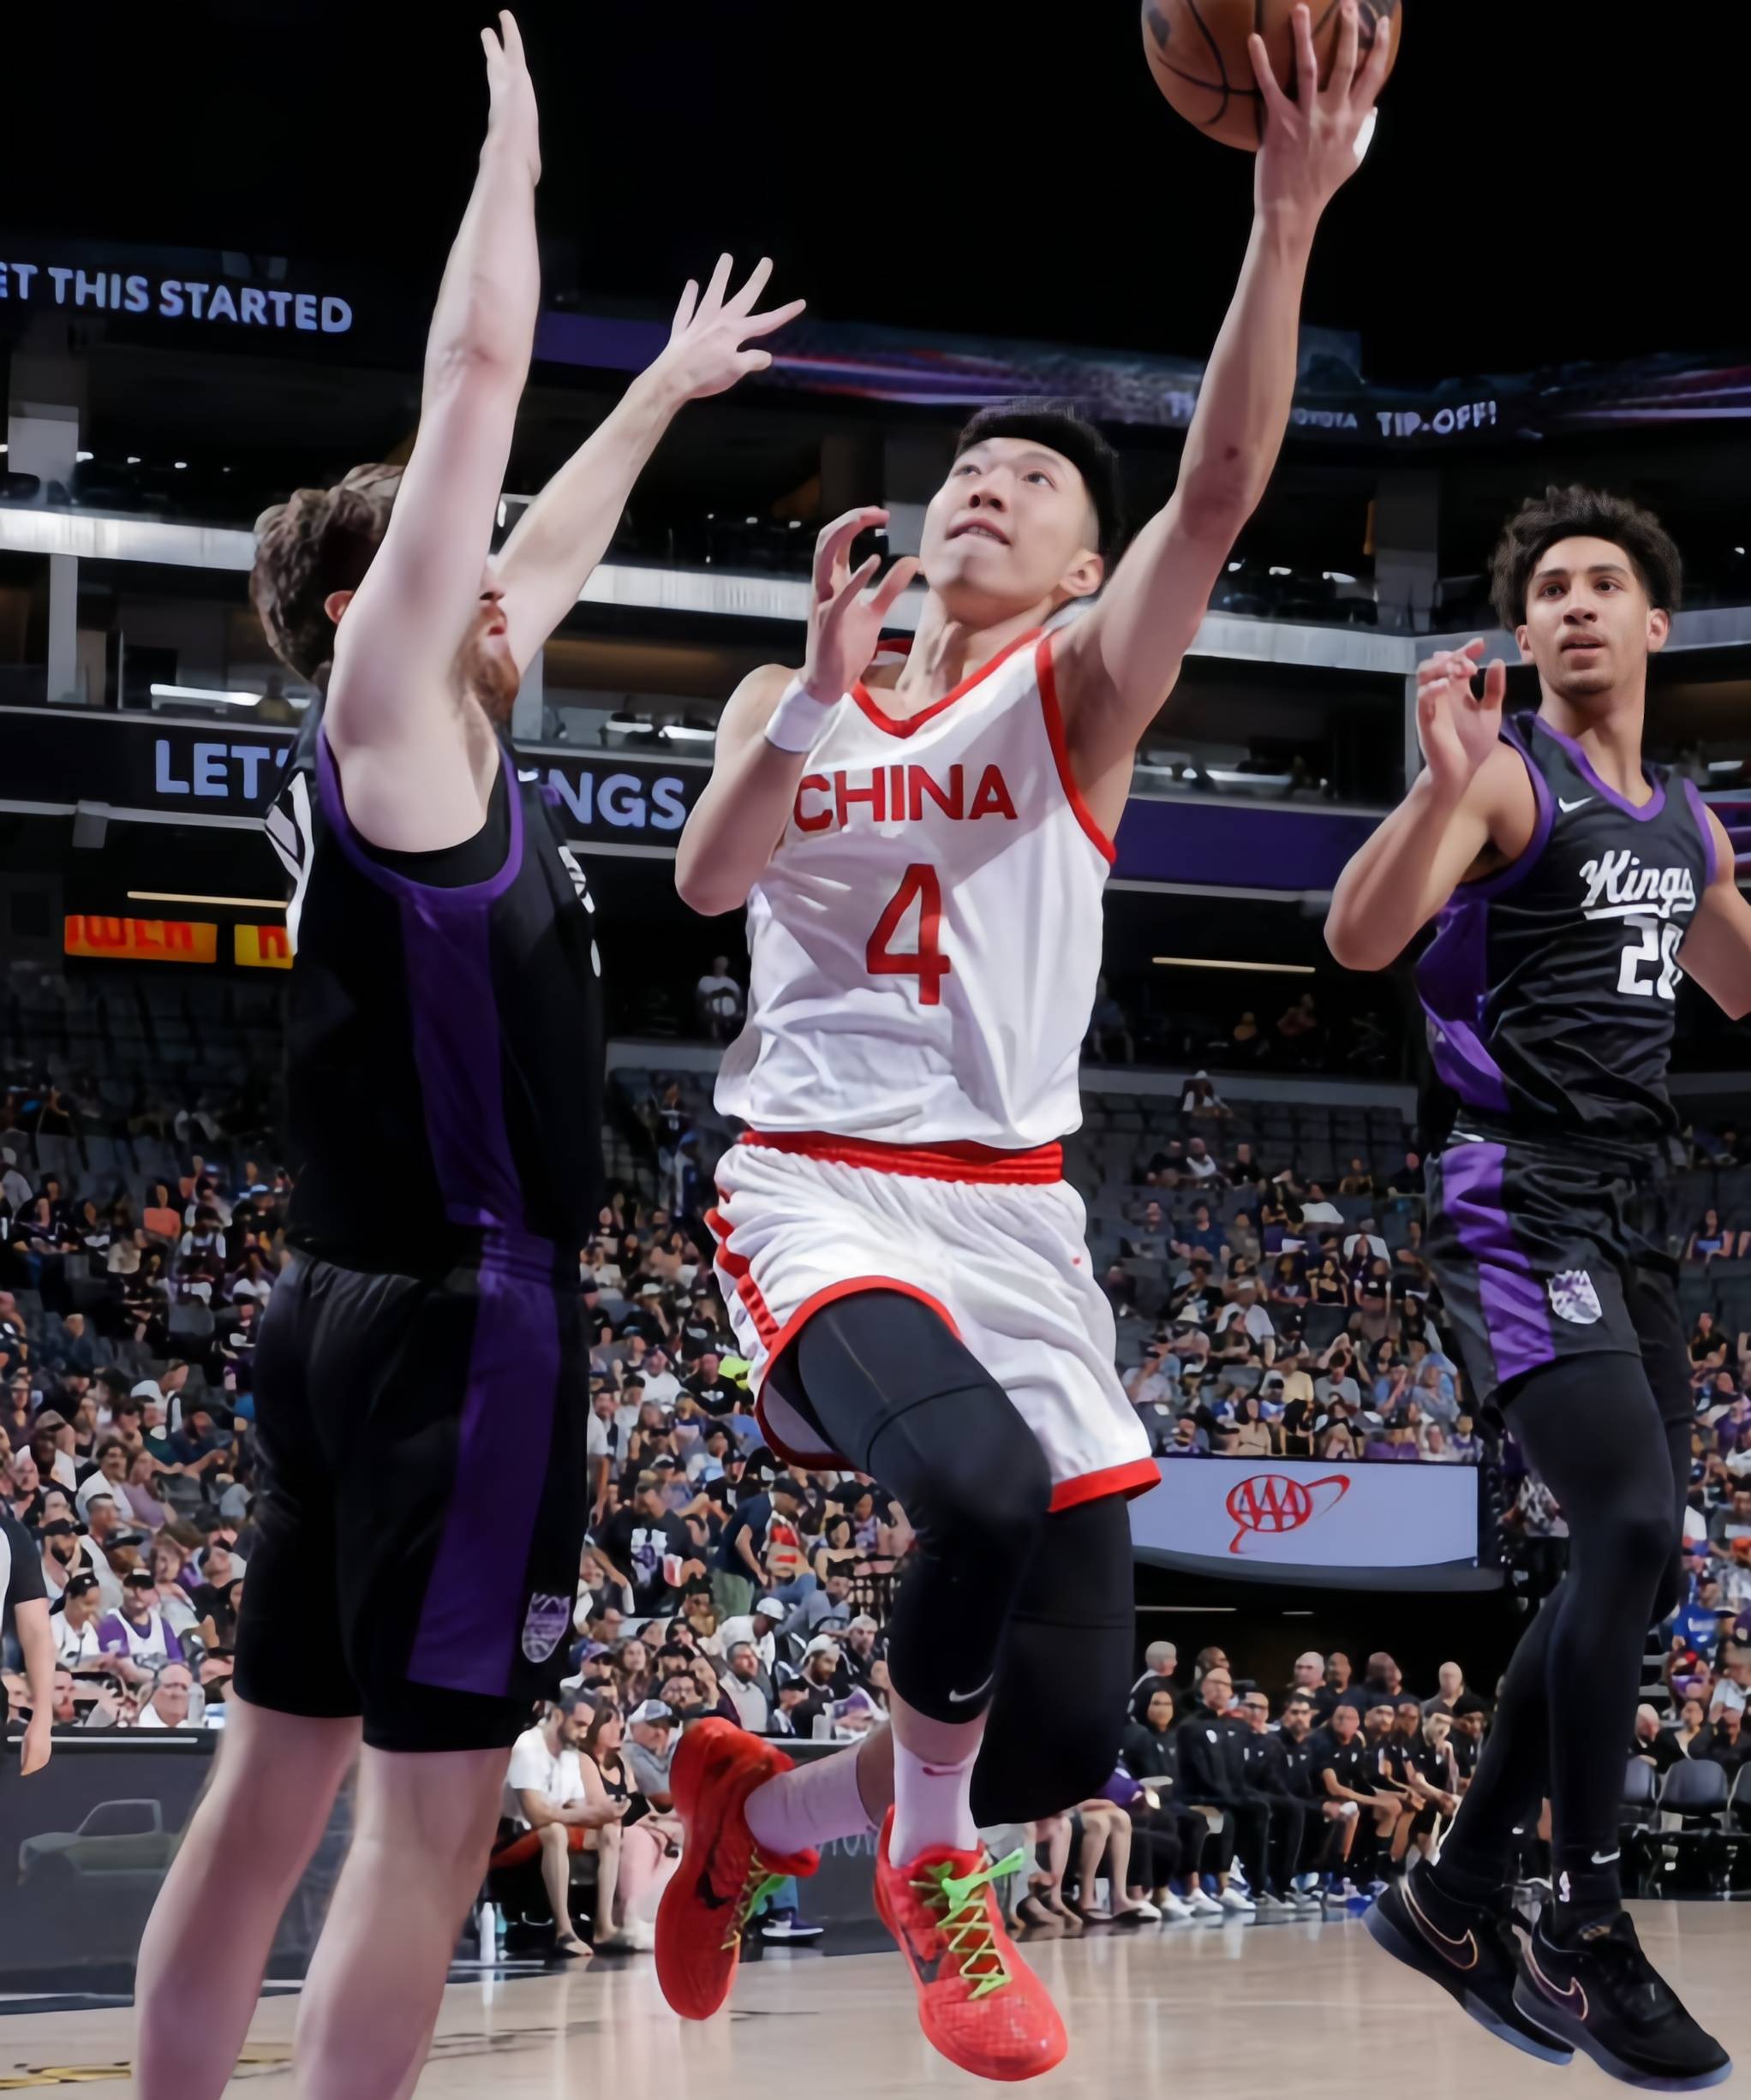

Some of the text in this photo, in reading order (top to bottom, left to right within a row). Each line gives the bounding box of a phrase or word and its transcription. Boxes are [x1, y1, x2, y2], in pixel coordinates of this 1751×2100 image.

[48, 266, 149, 312] THIS
[159, 280, 353, 333] STARTED
[1292, 400, 1497, 438] OYOTA TIP-OFF!
[155, 739, 686, 830] LET' NGS
[793, 763, 1019, 832] CHINA
[1579, 850, 1696, 919] Kings
[866, 863, 951, 1005] 4
[1232, 1475, 1307, 1533] AAA
